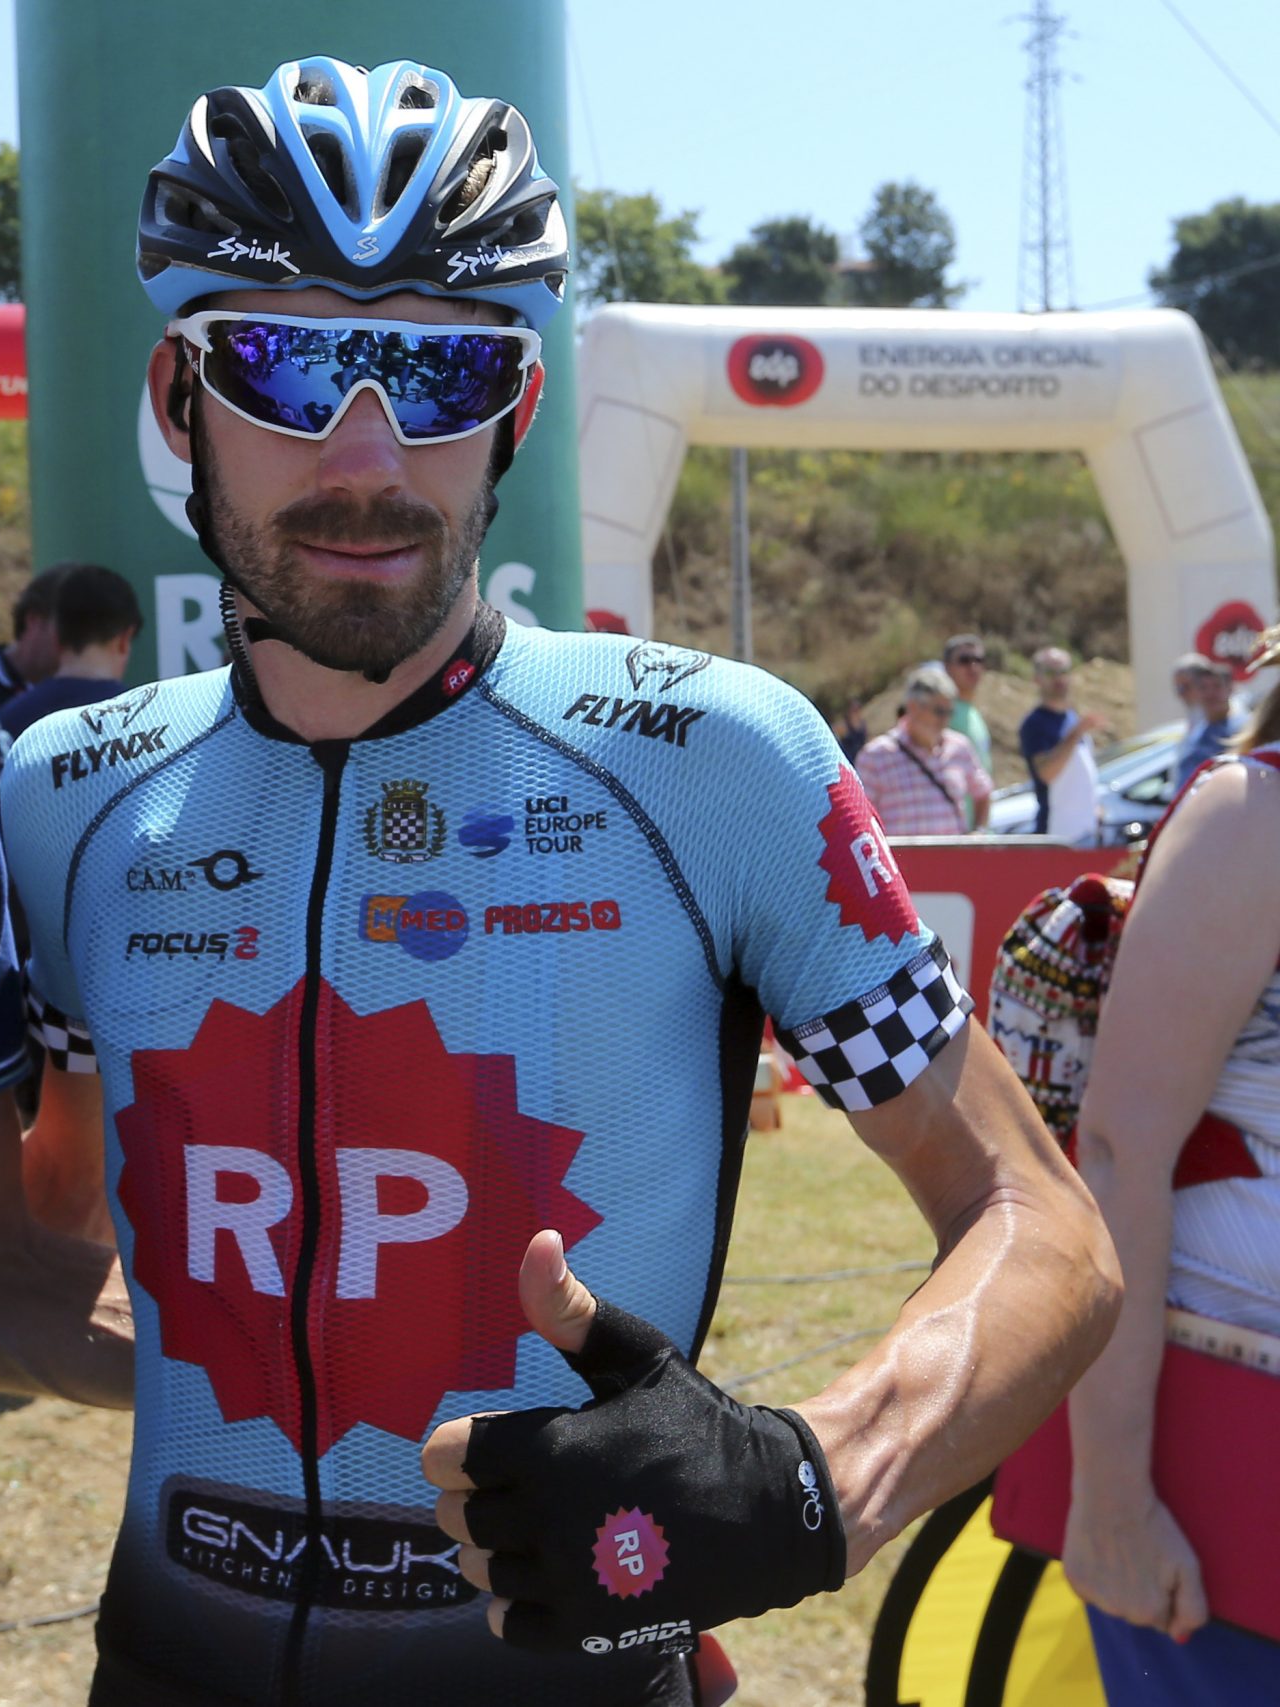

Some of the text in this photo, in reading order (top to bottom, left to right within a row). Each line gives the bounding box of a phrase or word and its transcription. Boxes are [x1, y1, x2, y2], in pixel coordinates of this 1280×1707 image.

[206, 235, 302, 275] Spiuk
[748, 349, 801, 389] edp
[858, 343, 986, 369] ENERGIA
[858, 373, 1063, 398] DO DESPORTO
[525, 796, 569, 815] UCI
[525, 811, 608, 836] EUROPE
[526, 836, 584, 855] TOUR
[484, 901, 590, 935] PROZIS
[126, 932, 231, 955] FOCUS
[183, 1143, 470, 1299] RP
[614, 1529, 646, 1577] RP
[180, 1545, 461, 1599] KITCHEN DESIGN
[617, 1619, 692, 1651] ONDA
